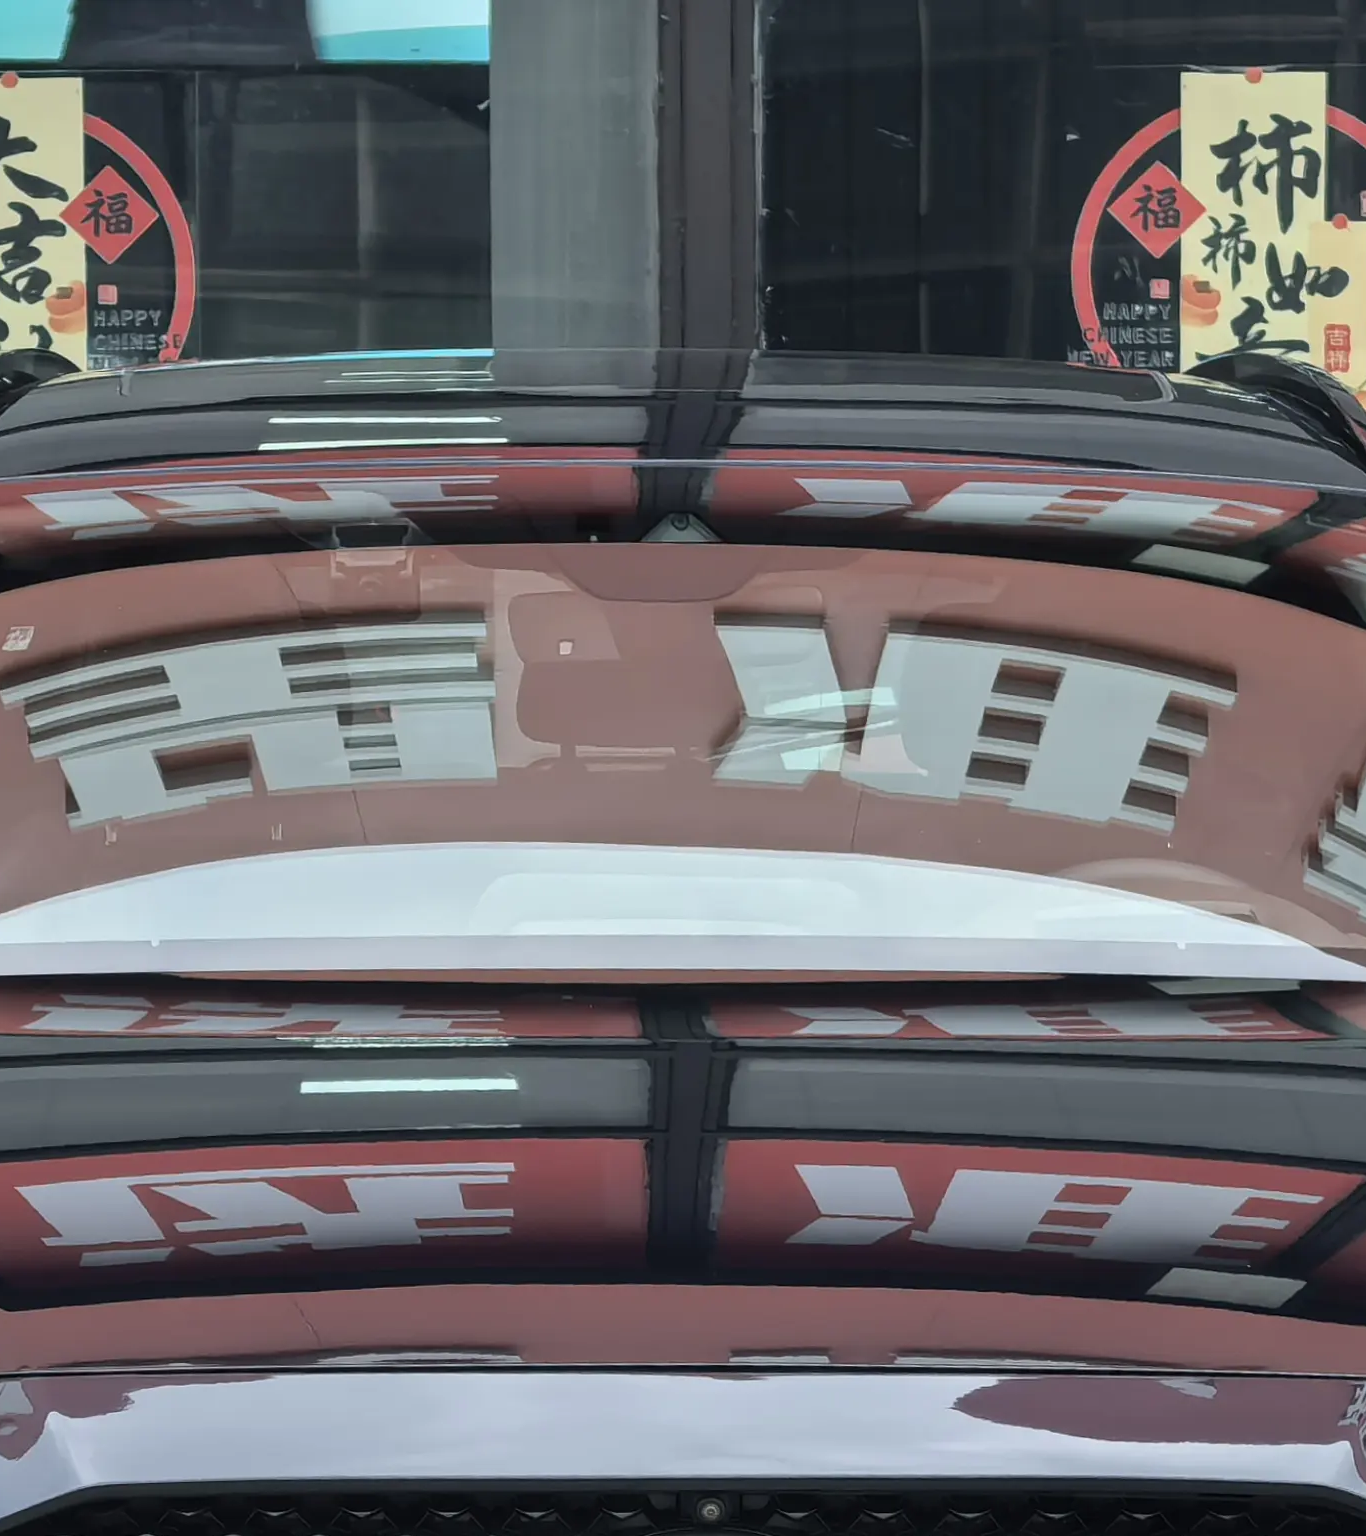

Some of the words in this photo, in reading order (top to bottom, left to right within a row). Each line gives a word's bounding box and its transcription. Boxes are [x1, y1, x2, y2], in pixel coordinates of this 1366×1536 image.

[79, 189, 134, 238] 福
[1129, 184, 1181, 232] 福
[93, 309, 162, 328] HAPPY
[1102, 301, 1172, 321] HAPPY
[94, 332, 184, 351] CHINESE
[1083, 326, 1175, 345] CHINESE
[1120, 349, 1175, 368] YEAR
